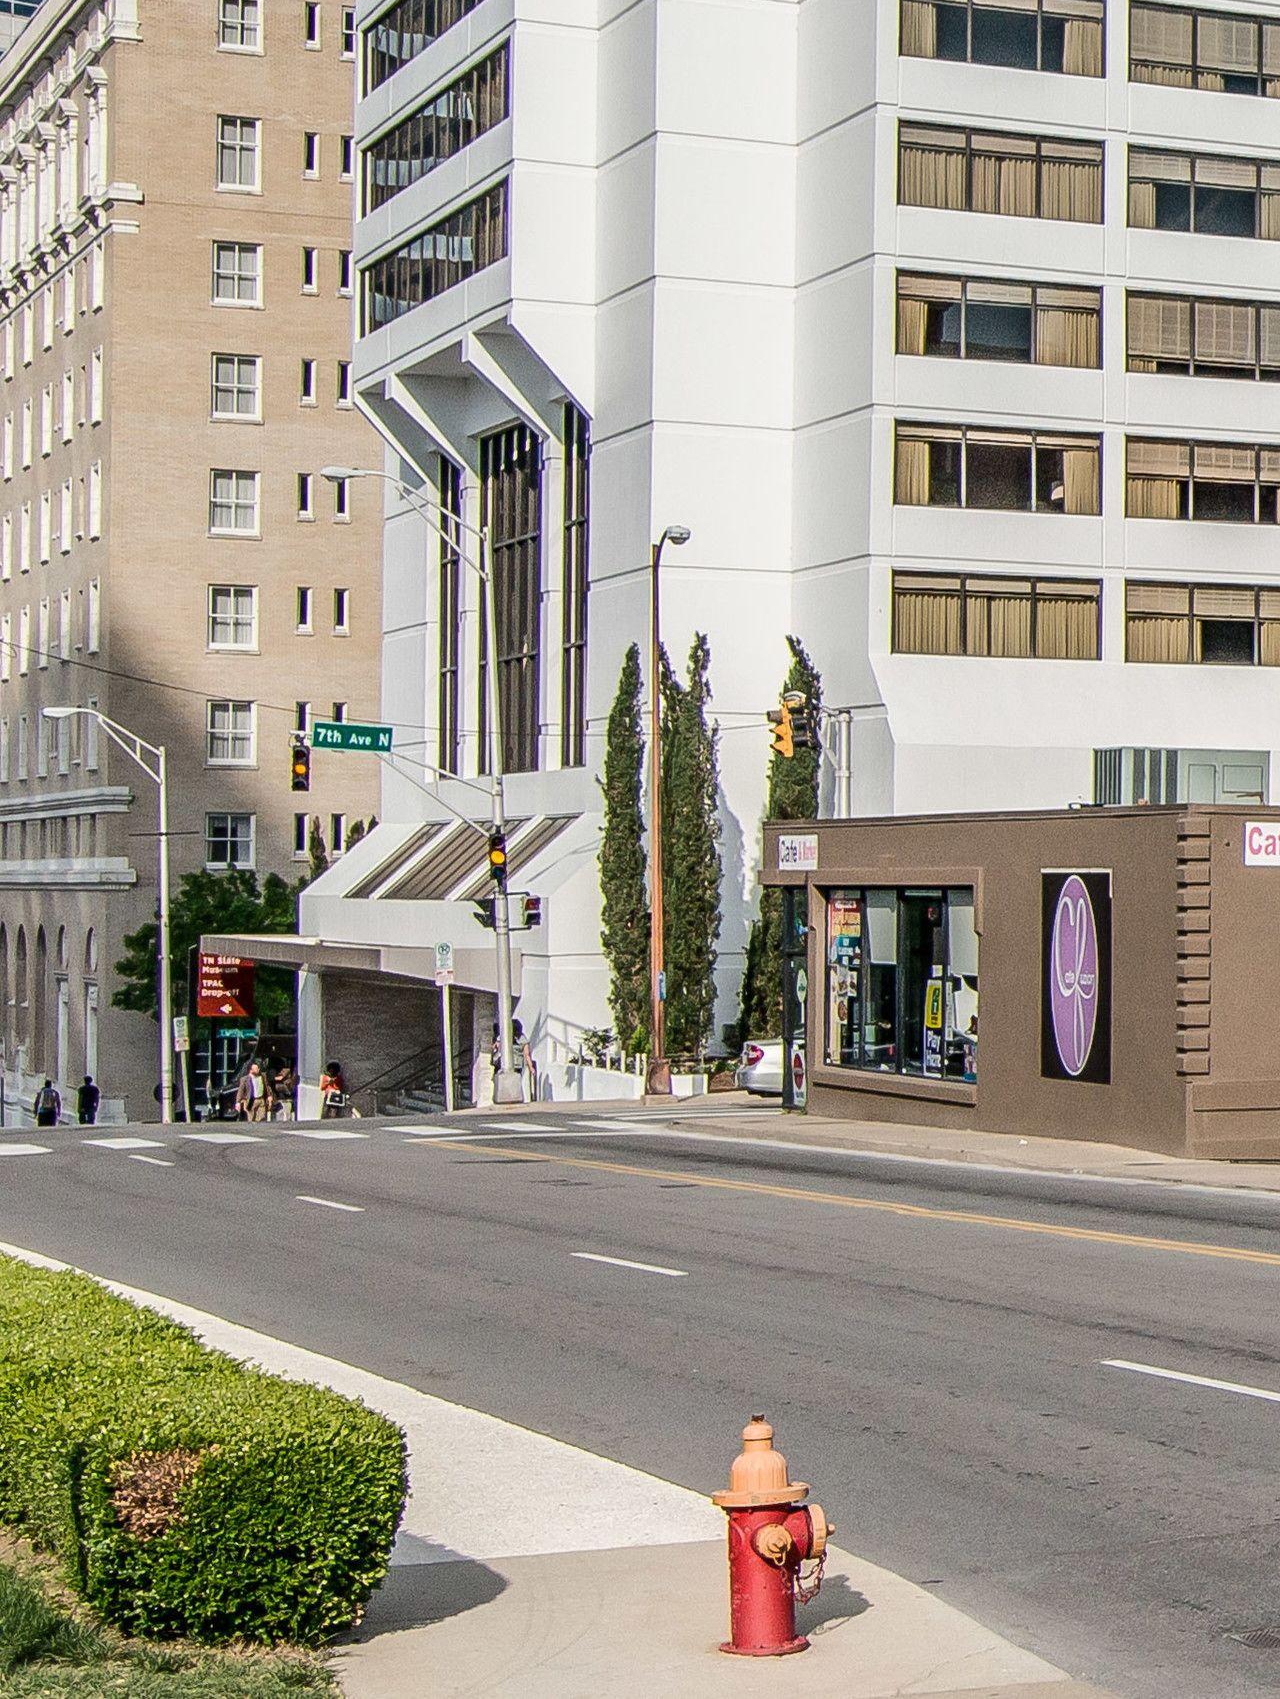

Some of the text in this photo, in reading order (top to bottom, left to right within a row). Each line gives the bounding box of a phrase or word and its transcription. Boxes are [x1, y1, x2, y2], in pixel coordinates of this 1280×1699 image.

[316, 728, 390, 746] 7th Ave N
